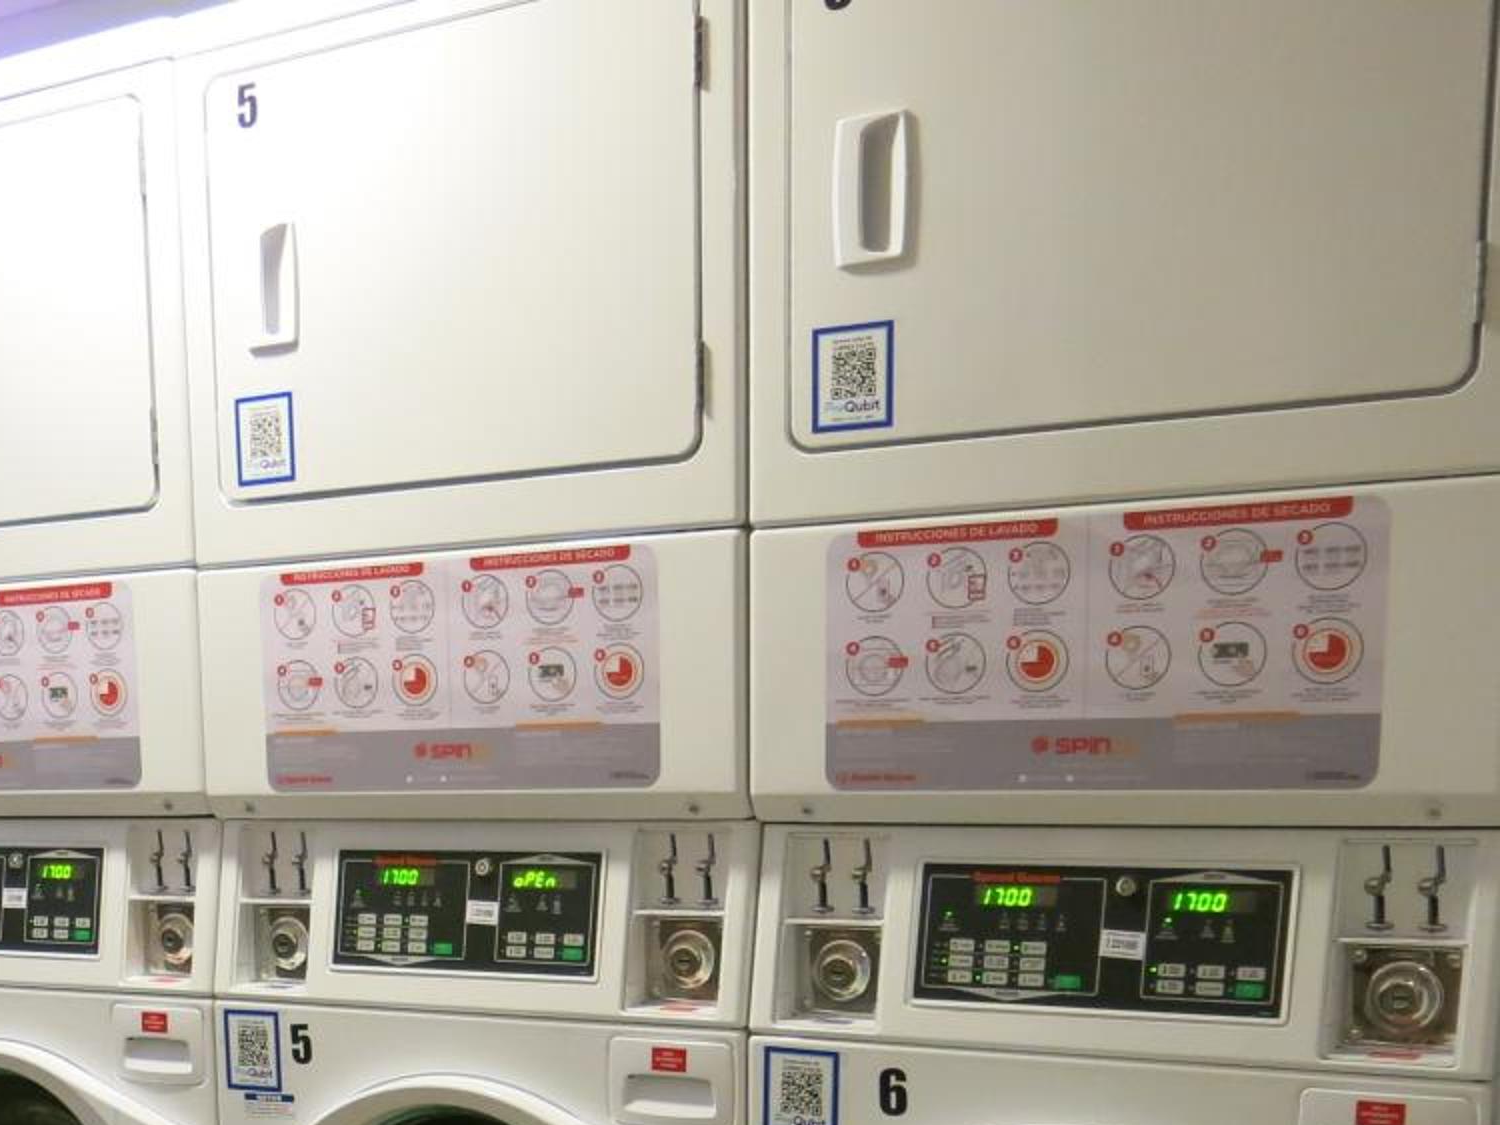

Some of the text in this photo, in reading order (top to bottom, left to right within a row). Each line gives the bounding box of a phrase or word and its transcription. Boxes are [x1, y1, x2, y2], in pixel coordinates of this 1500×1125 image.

[236, 83, 258, 128] 5
[1143, 502, 1332, 525] INSTRUCCIONES DE SECADO
[875, 523, 1039, 542] INSTRUCCIONES DE LAVADO
[983, 887, 1034, 907] 1700
[1173, 892, 1228, 912] 1700
[290, 1023, 313, 1065] 5
[878, 1067, 908, 1117] 6
